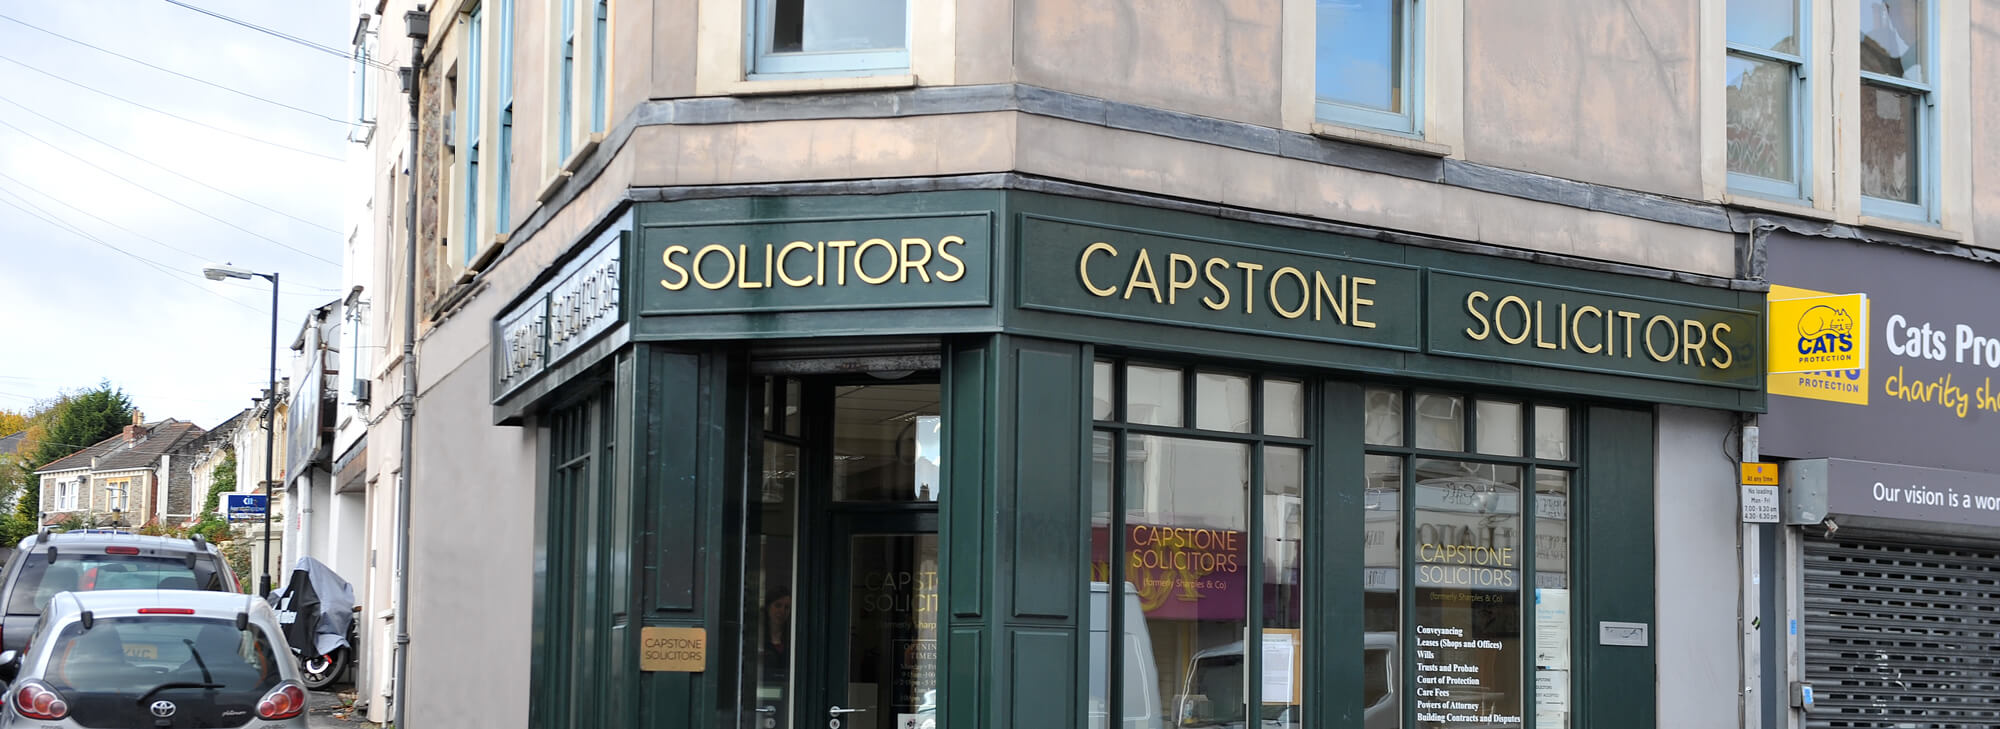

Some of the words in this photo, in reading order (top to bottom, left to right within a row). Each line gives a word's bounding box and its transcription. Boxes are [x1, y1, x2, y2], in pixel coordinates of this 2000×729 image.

[660, 235, 966, 291] SOLICITORS
[1079, 242, 1377, 329] CAPSTONE
[1465, 290, 1734, 370] SOLICITORS
[1797, 332, 1853, 355] CATS
[1885, 314, 1947, 361] Cats
[1955, 323, 2000, 369] Pro
[1798, 354, 1852, 364] PROTECTION
[1798, 377, 1860, 393] PROTECTION
[1884, 365, 1969, 419] charity
[1873, 482, 1901, 503] Our
[1904, 485, 1944, 506] vision
[1948, 488, 1959, 508] is
[1962, 494, 1972, 509] a
[1132, 525, 1239, 551] CAPSTONE
[1132, 549, 1239, 573] SOLICITORS
[1420, 543, 1513, 567] CAPSTONE
[864, 570, 939, 593] CAPST
[1419, 565, 1513, 587] SOLICITORS
[1206, 580, 1214, 589] &
[1214, 580, 1227, 590] Co)
[1491, 593, 1504, 604] Co)
[1416, 625, 1463, 637] Conveyancing
[645, 638, 702, 649] CAPSTONE
[1416, 638, 1439, 647] Leases
[1440, 638, 1463, 650] (Shops
[1463, 640, 1476, 649] and
[1477, 640, 1503, 651] Offices)
[645, 650, 703, 661] SOLICITORS
[1416, 650, 1435, 659] Wills
[1416, 663, 1439, 672] Trusts
[1439, 664, 1452, 672] and
[1453, 664, 1479, 673] Probate
[1416, 675, 1437, 684] Court
[1438, 675, 1446, 684] of
[1446, 676, 1480, 686] Protection
[1416, 688, 1434, 697] Care
[1434, 688, 1450, 697] Fees
[1417, 700, 1441, 709] Powers
[1442, 700, 1450, 709] of
[1450, 701, 1480, 711] Attorney
[1417, 713, 1446, 723] Building
[1446, 713, 1479, 722] Contracts
[1479, 714, 1493, 722] and
[1493, 714, 1521, 724] Disputes
